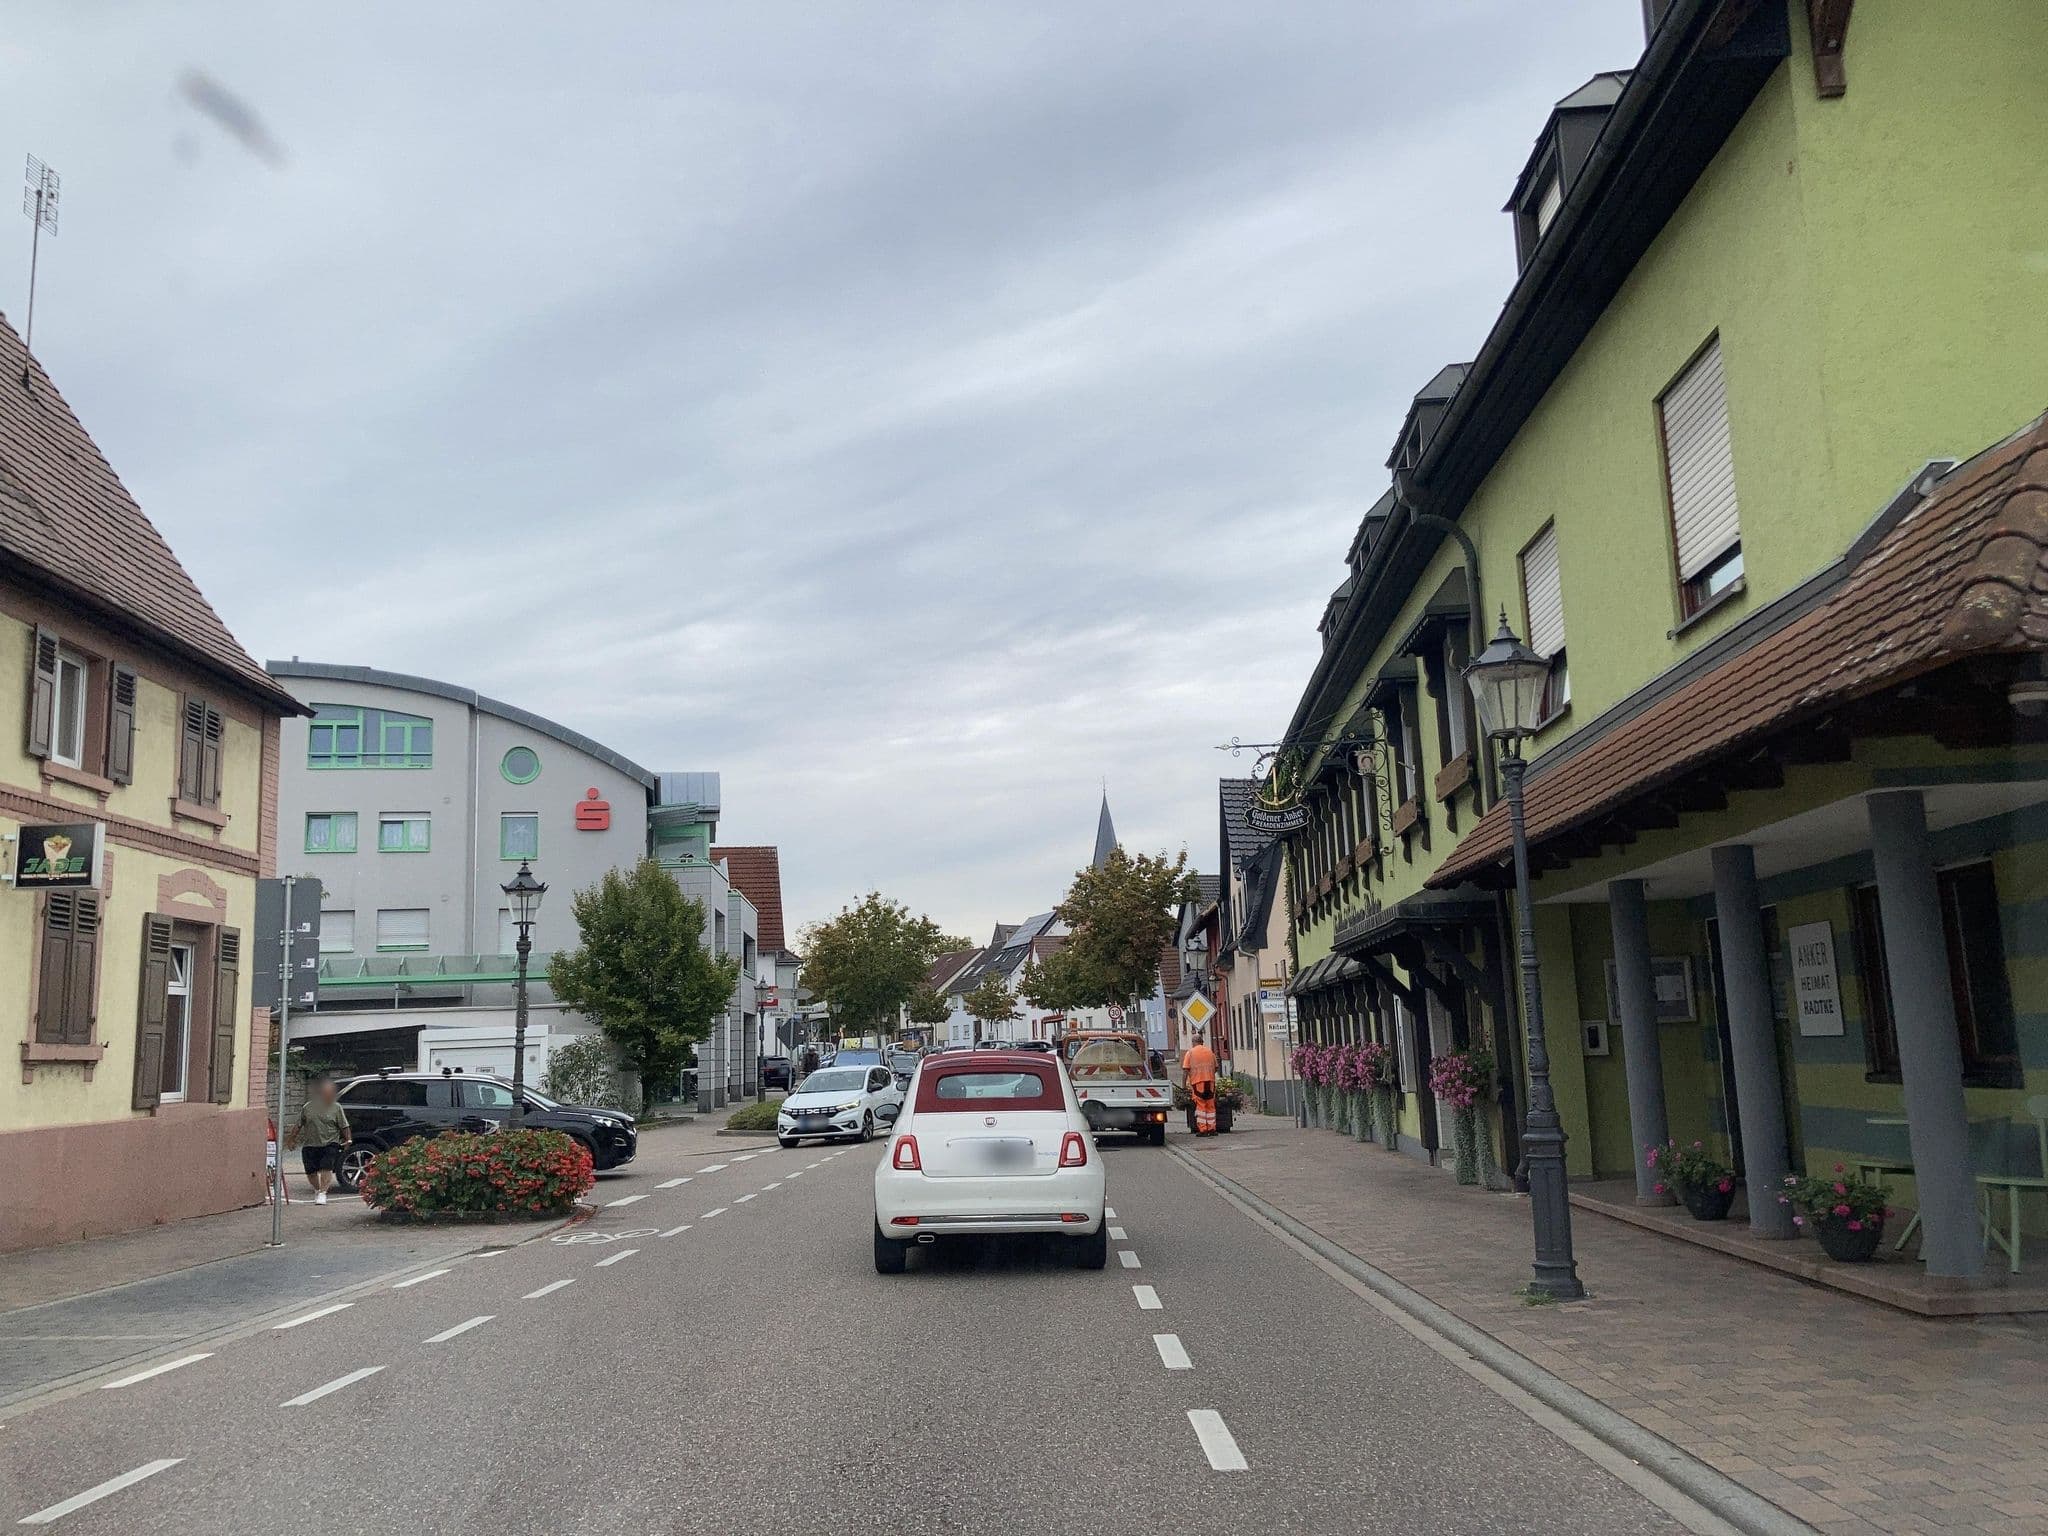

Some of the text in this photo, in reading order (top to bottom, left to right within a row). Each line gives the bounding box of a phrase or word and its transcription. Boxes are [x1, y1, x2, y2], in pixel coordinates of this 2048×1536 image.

[1251, 817, 1305, 829] FREMDENZIMMER
[1252, 809, 1304, 822] Goldener Anker
[23, 856, 86, 873] JADE
[1798, 942, 1827, 968] ANKER
[1801, 975, 1830, 991] HEIMAT
[1110, 1009, 1119, 1017] 30
[1804, 999, 1834, 1015] RADTKE
